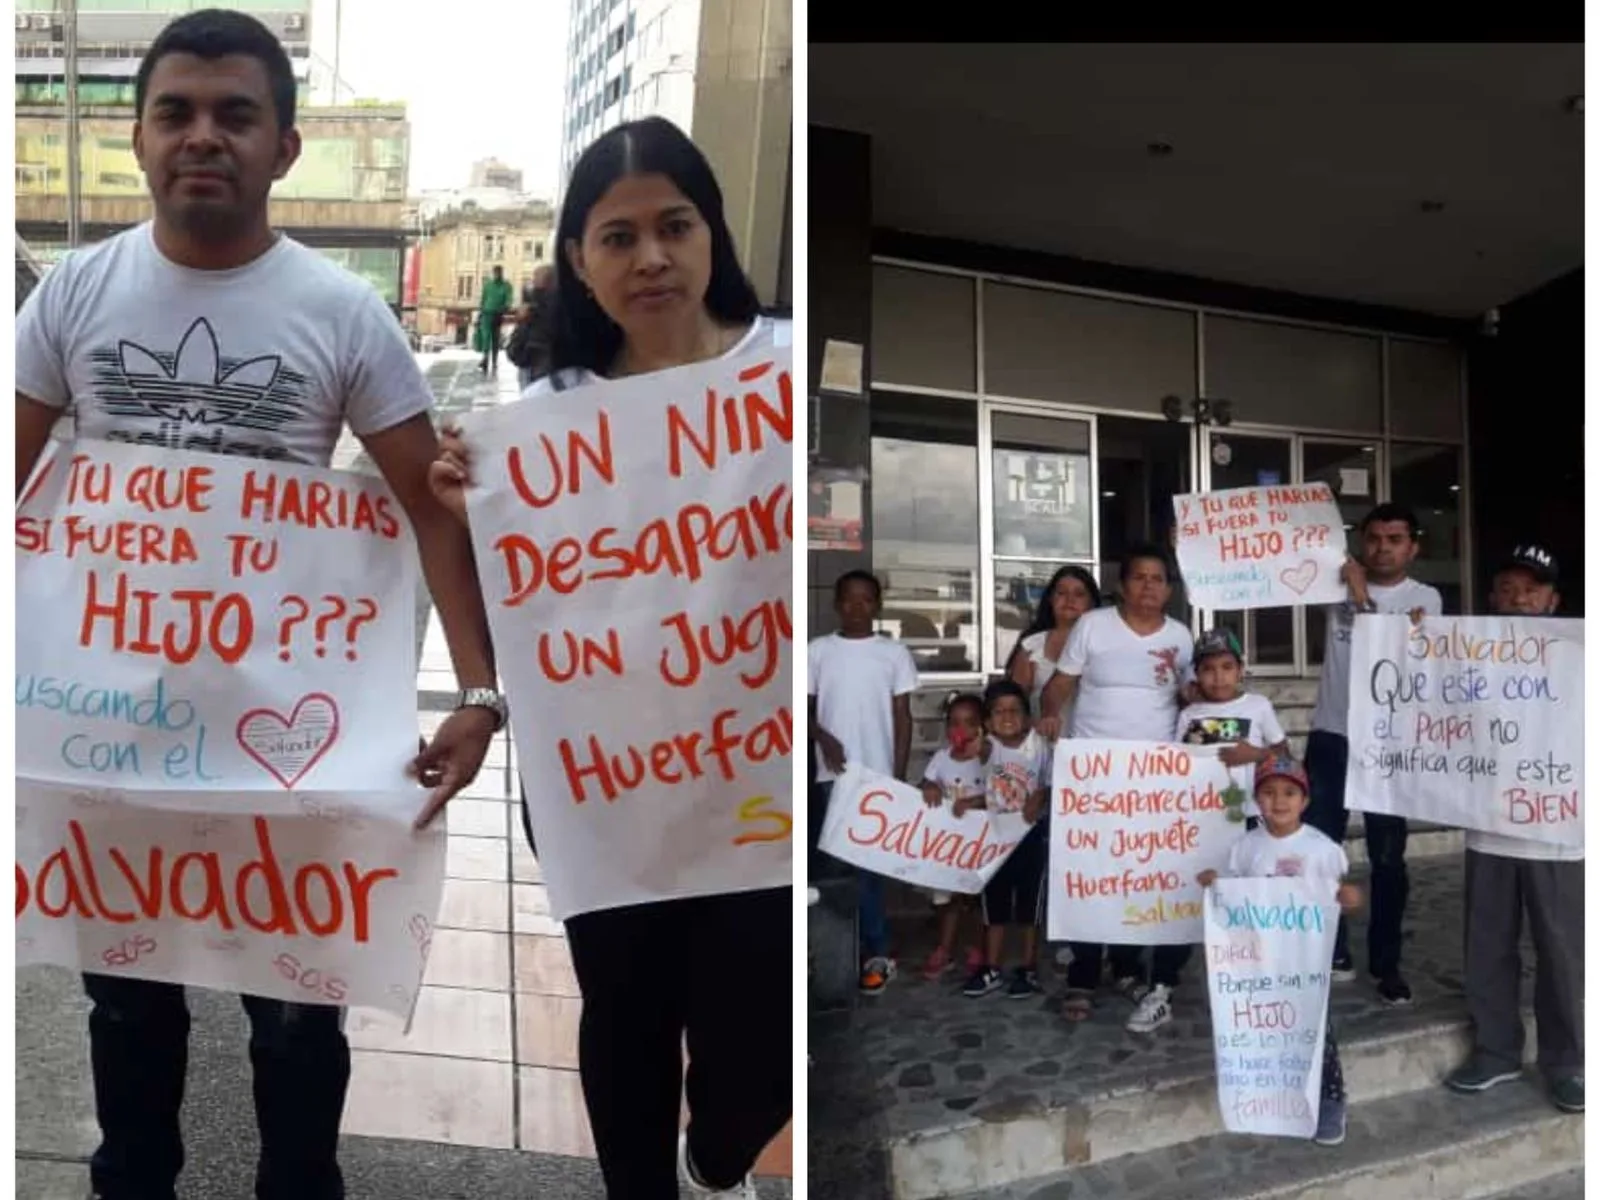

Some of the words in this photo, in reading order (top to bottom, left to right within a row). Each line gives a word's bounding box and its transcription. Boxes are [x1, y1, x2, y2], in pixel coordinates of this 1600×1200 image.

[507, 410, 614, 509] UN
[666, 361, 792, 478] NIÑ
[66, 455, 112, 505] TU
[126, 465, 215, 514] QUE
[240, 469, 399, 539] HARIAS
[1180, 502, 1190, 519] Y
[1200, 495, 1223, 515] TU
[1228, 490, 1257, 510] QUE
[1266, 486, 1332, 506] HARIAS
[1182, 522, 1200, 537] SI
[1207, 512, 1259, 535] FUERA
[1267, 510, 1288, 527] TU
[15, 517, 53, 554] SI
[64, 514, 198, 565] FUERA
[225, 534, 278, 577] TU
[1219, 530, 1283, 562] HIJO
[1524, 545, 1551, 567] AM
[79, 569, 254, 664] HIJO
[276, 595, 378, 662] ???
[537, 628, 623, 684] UN
[1407, 624, 1562, 665] Salvador
[1371, 659, 1427, 712] Que
[1442, 668, 1489, 703] este
[1373, 712, 1402, 740] el
[1489, 717, 1520, 744] no
[164, 723, 223, 782] el
[1070, 749, 1111, 781] UN
[1128, 745, 1191, 780] NIÑO
[1456, 756, 1498, 781] que
[1516, 751, 1573, 785] este
[1067, 828, 1098, 850] UN
[1233, 999, 1297, 1029] HIJO
